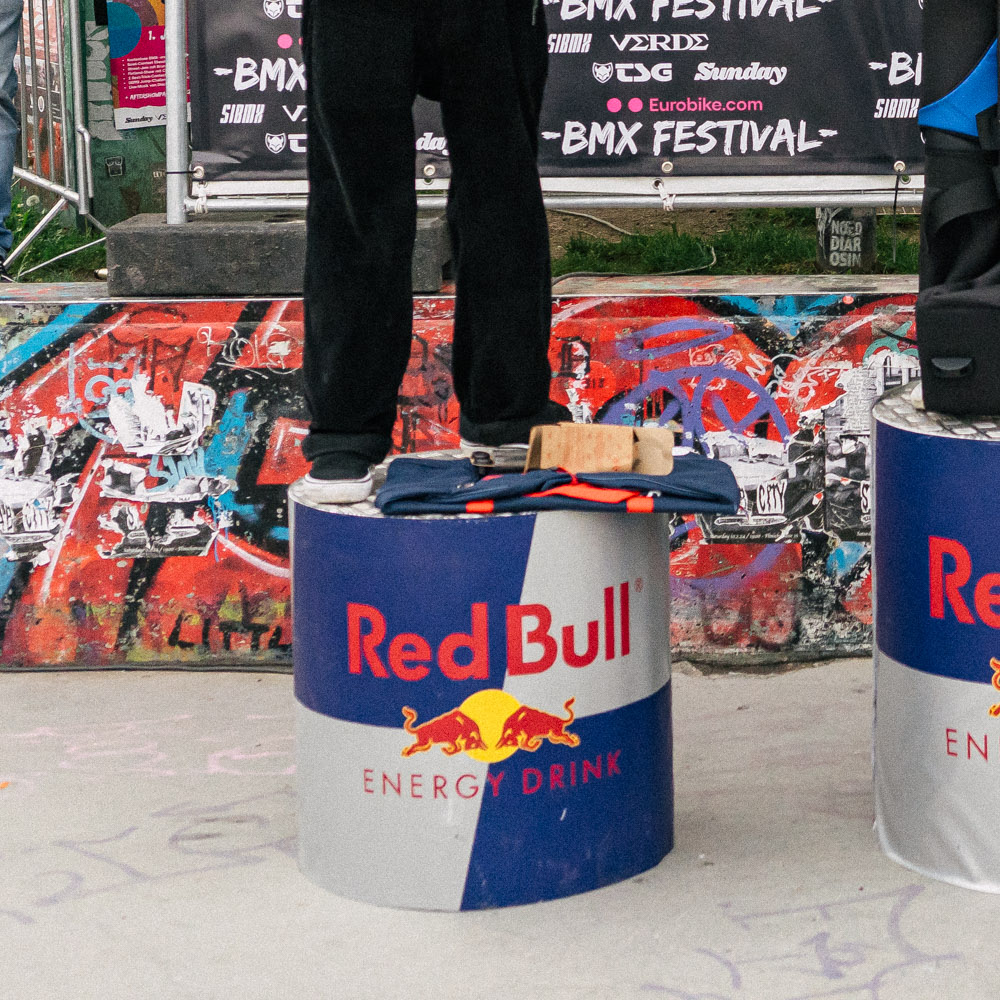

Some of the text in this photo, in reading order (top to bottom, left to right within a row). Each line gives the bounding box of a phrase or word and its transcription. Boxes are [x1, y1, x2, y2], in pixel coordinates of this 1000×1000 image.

[616, 62, 788, 86] TSG Sunday
[650, 97, 763, 112] Eurobike.com
[125, 114, 153, 123] Sunday
[758, 482, 784, 513] CITY
[347, 581, 631, 681] Red Bull
[363, 749, 622, 800] ENERGY DRINK
